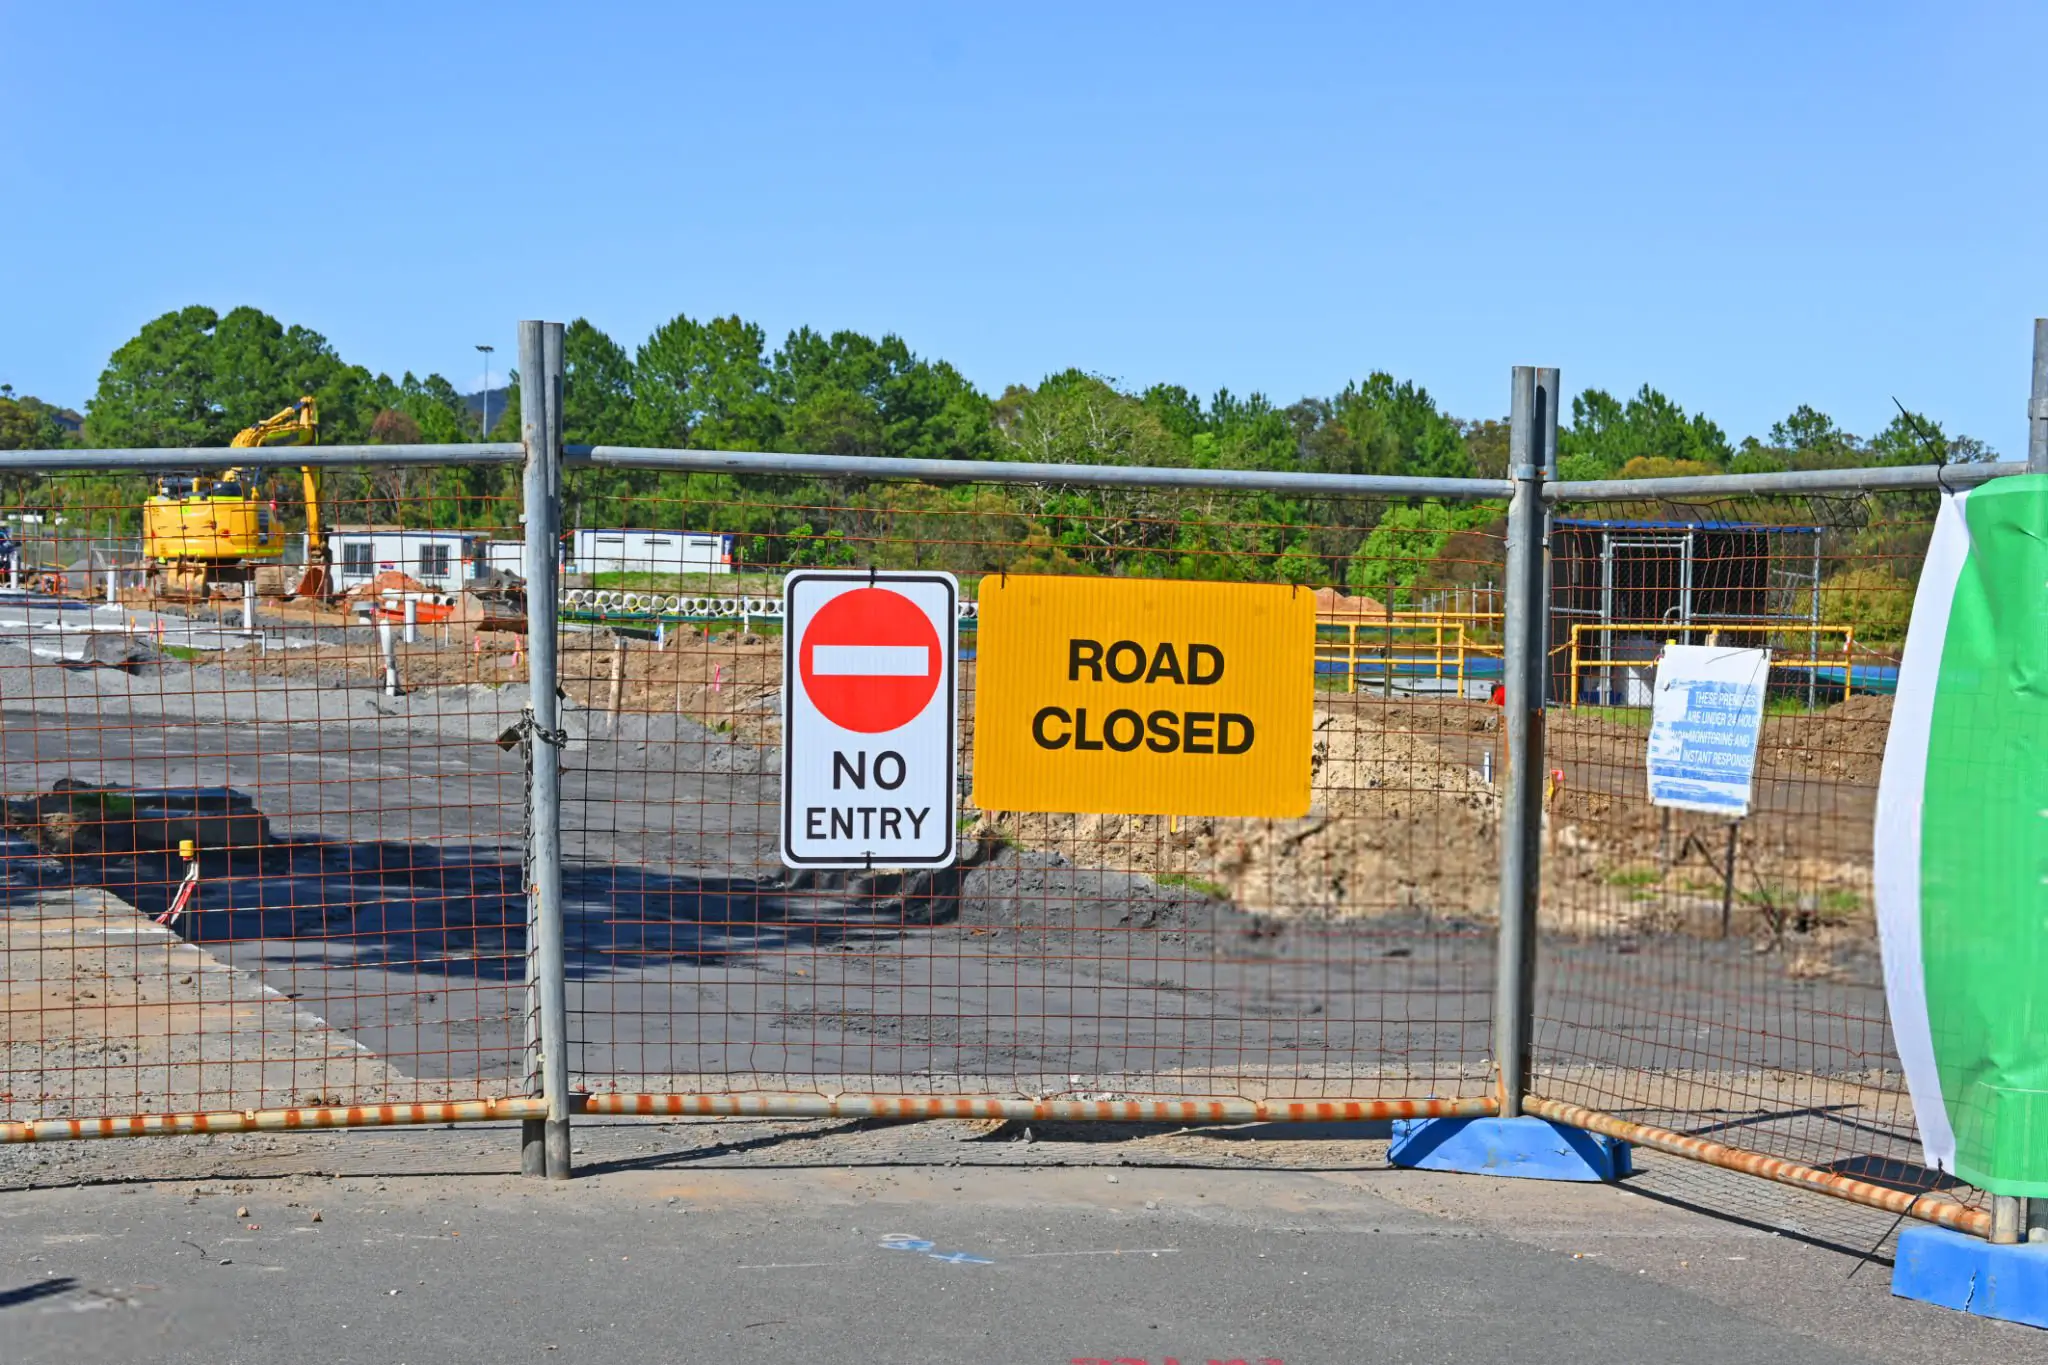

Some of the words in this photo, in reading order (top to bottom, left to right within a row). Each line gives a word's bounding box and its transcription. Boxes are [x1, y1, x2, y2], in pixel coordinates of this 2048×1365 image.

[1068, 638, 1225, 685] ROAD
[1695, 691, 1718, 705] THESE
[1719, 692, 1756, 708] PREMES
[1032, 706, 1255, 755] CLOSED
[1688, 710, 1701, 724] ARE
[1702, 711, 1726, 726] UNDER
[1727, 713, 1738, 727] 24
[1734, 734, 1750, 748] AND
[833, 751, 906, 790] NO
[1684, 749, 1712, 764] INSTANT
[1712, 752, 1752, 767] RESPONSE
[806, 807, 930, 839] ENTRY
